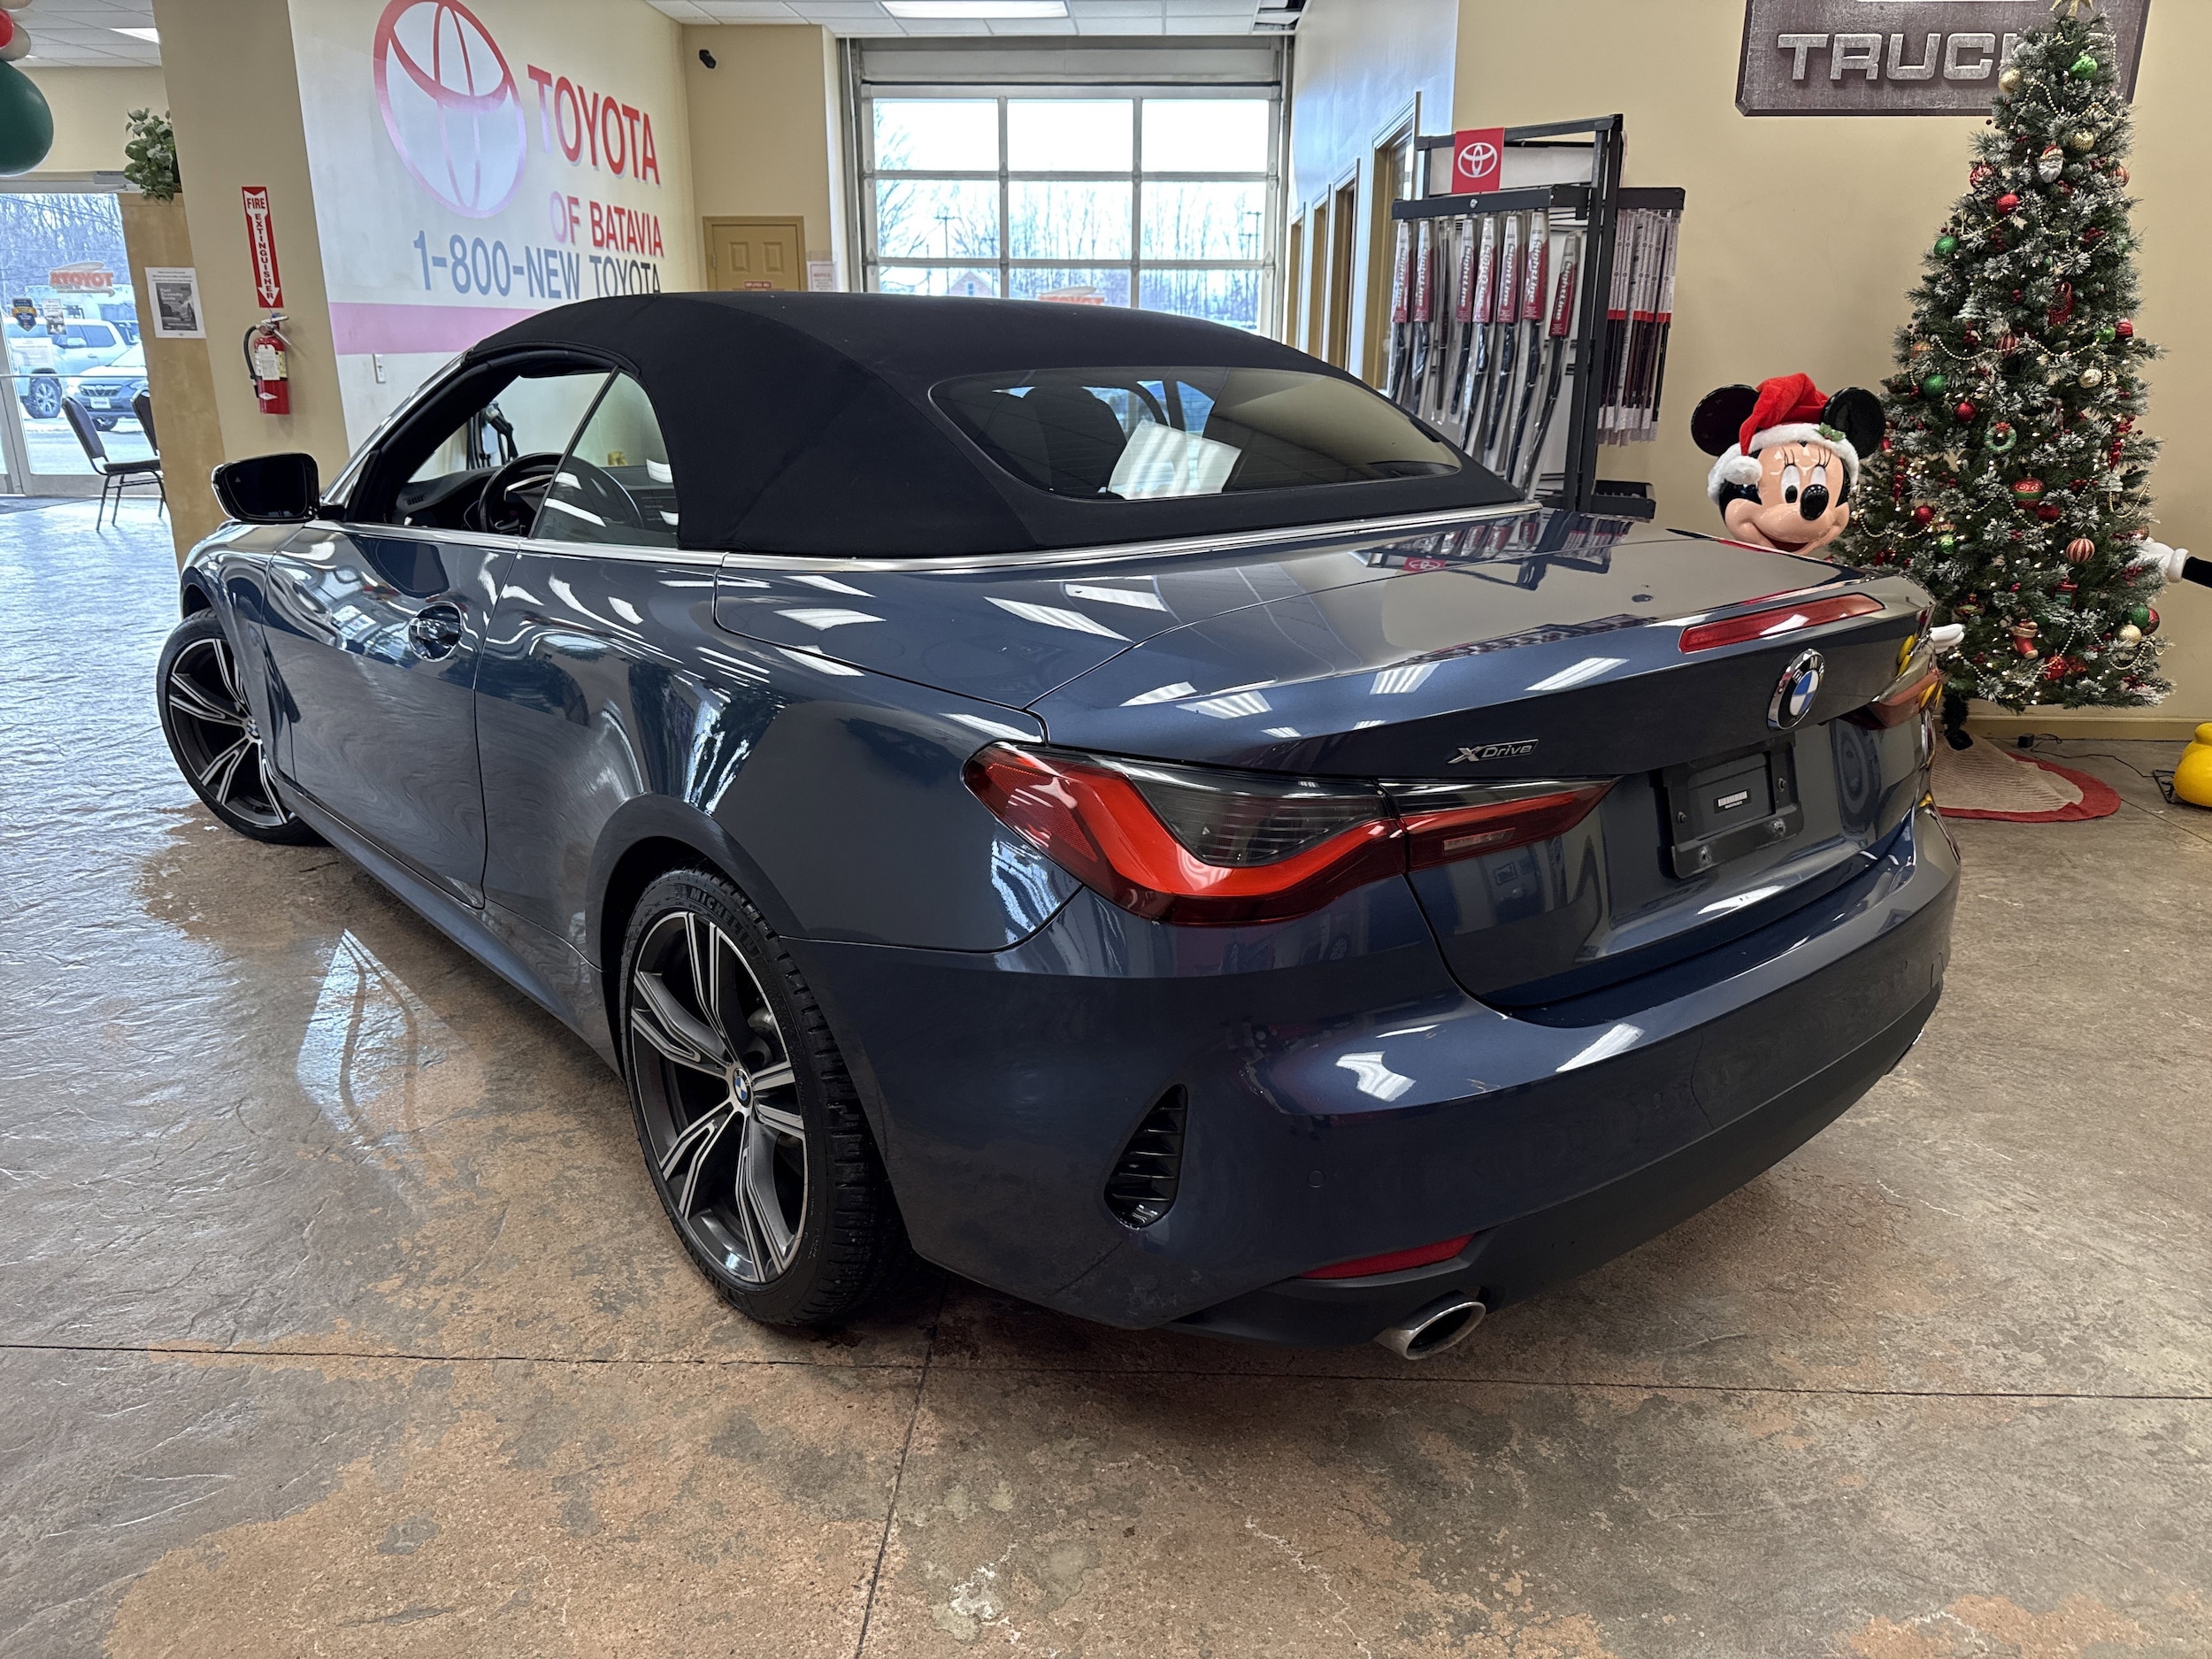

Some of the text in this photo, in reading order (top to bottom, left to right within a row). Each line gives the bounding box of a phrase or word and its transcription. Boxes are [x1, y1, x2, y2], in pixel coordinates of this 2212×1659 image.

[1777, 32, 2104, 81] TRUC
[527, 64, 661, 187] TOYOTA
[247, 197, 266, 210] FIRE
[550, 190, 664, 257] OF BATAVIA
[255, 213, 274, 299] EXTINGUISHER
[413, 230, 661, 300] 1-800-NEW TOYOTA
[690, 887, 760, 956] MICHELIN
